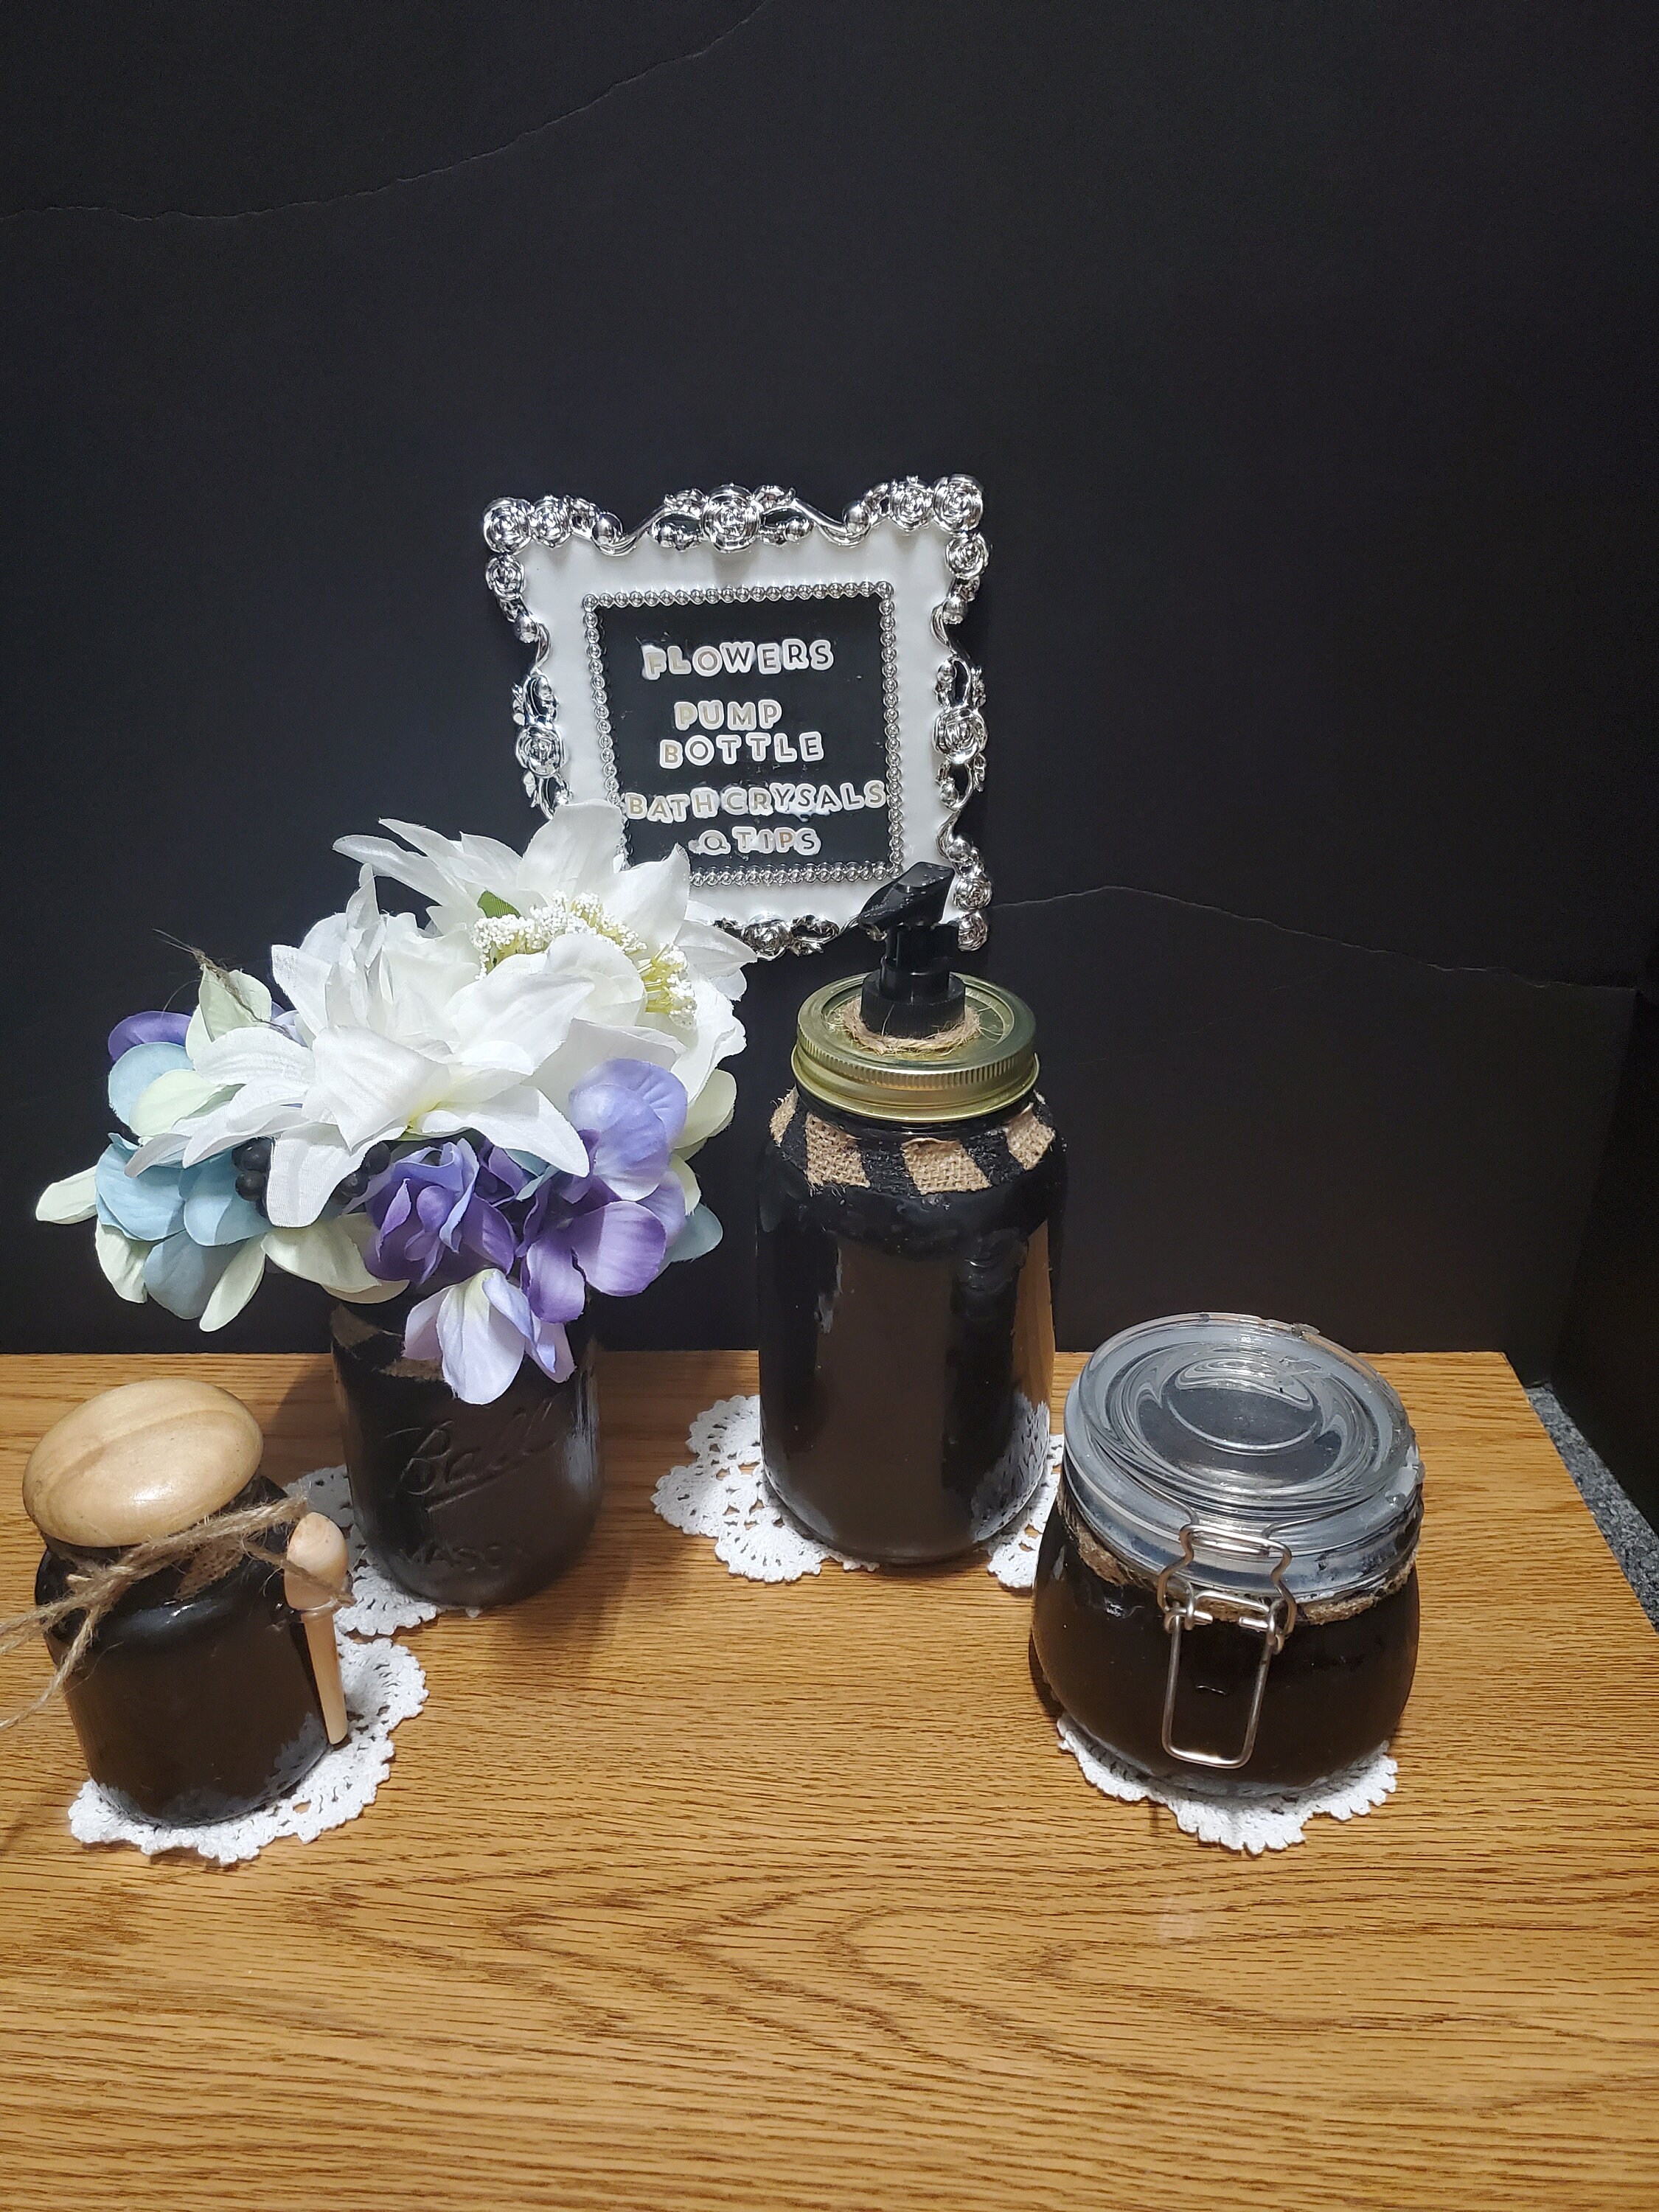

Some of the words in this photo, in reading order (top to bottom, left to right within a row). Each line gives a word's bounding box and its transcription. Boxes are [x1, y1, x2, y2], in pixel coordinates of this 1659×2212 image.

[642, 639, 834, 680] FLOWERS
[674, 700, 782, 730] PUMP
[660, 731, 824, 768] BOTTLE
[699, 830, 731, 855] Q
[732, 826, 820, 855] TIPS
